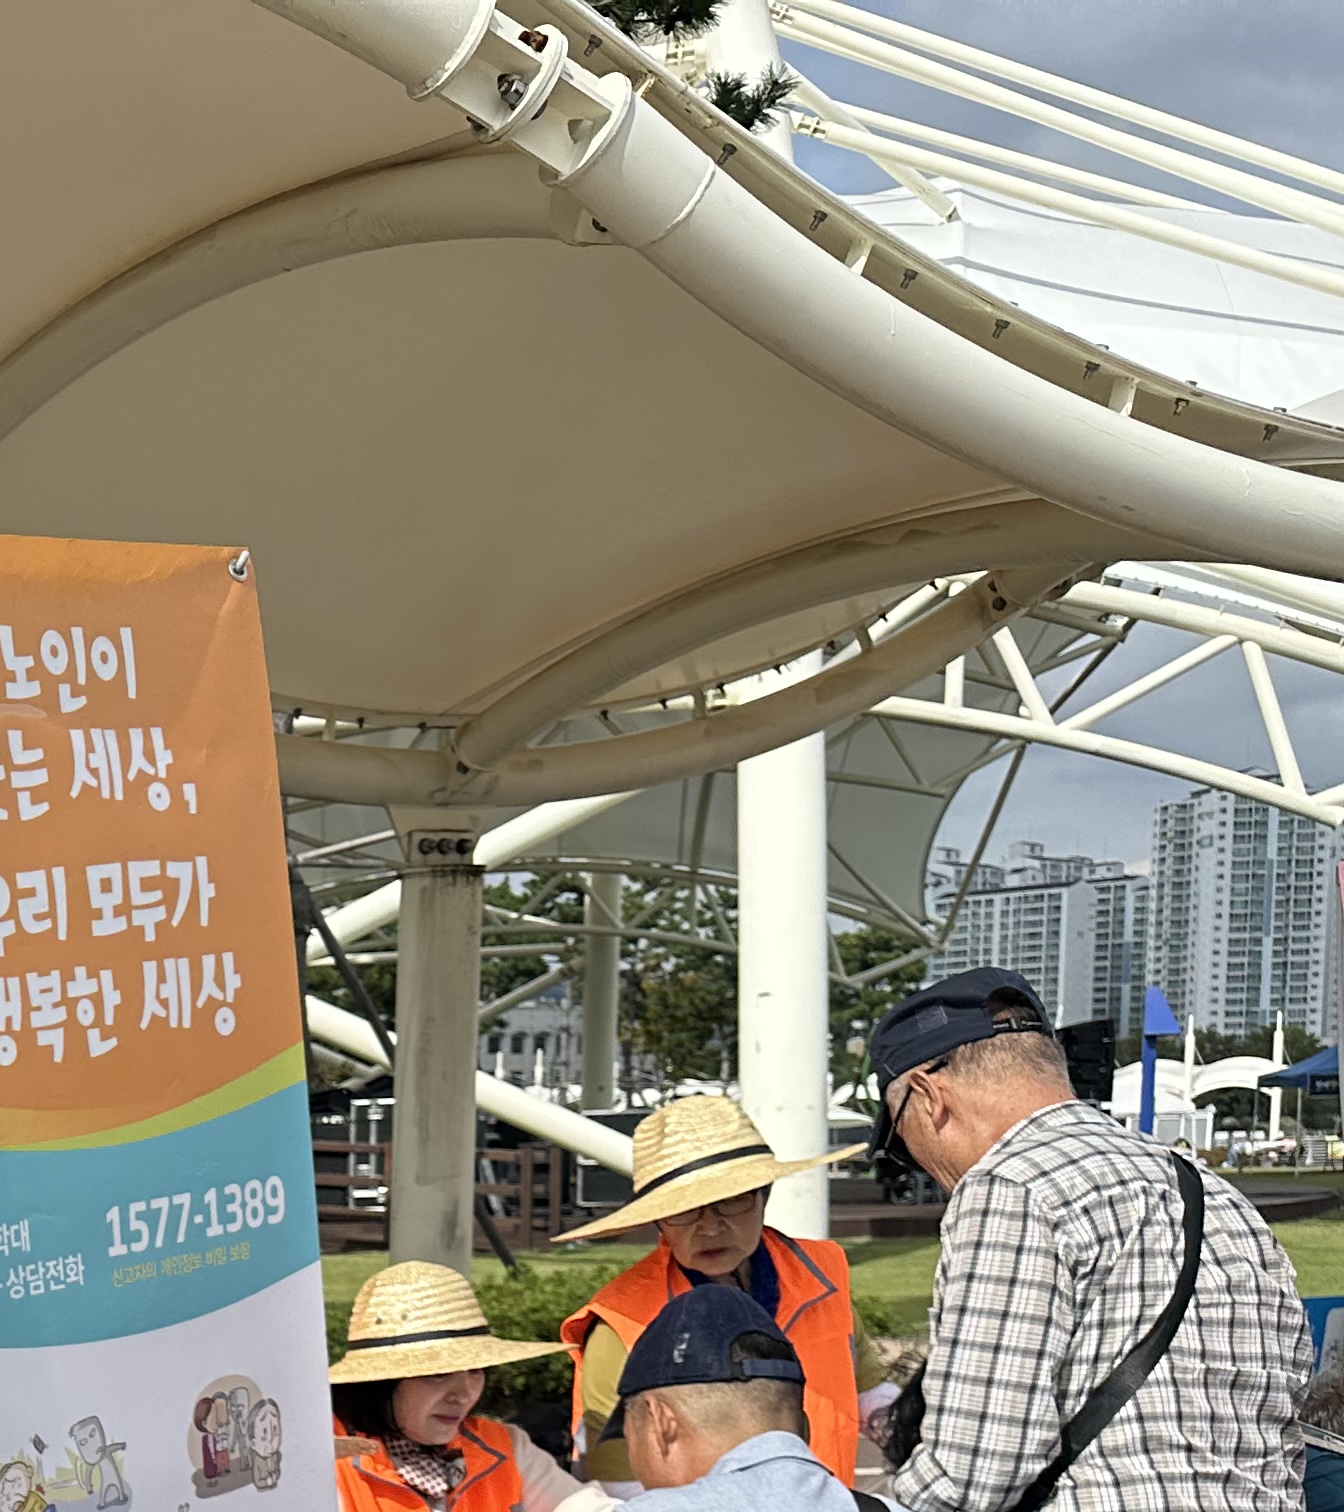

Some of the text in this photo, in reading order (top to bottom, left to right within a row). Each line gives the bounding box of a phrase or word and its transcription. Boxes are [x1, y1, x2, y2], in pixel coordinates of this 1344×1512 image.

[70, 727, 197, 814] 세상,
[86, 855, 215, 942] 모두가
[139, 951, 241, 1036] 세상
[106, 1175, 285, 1257] 1577-1389
